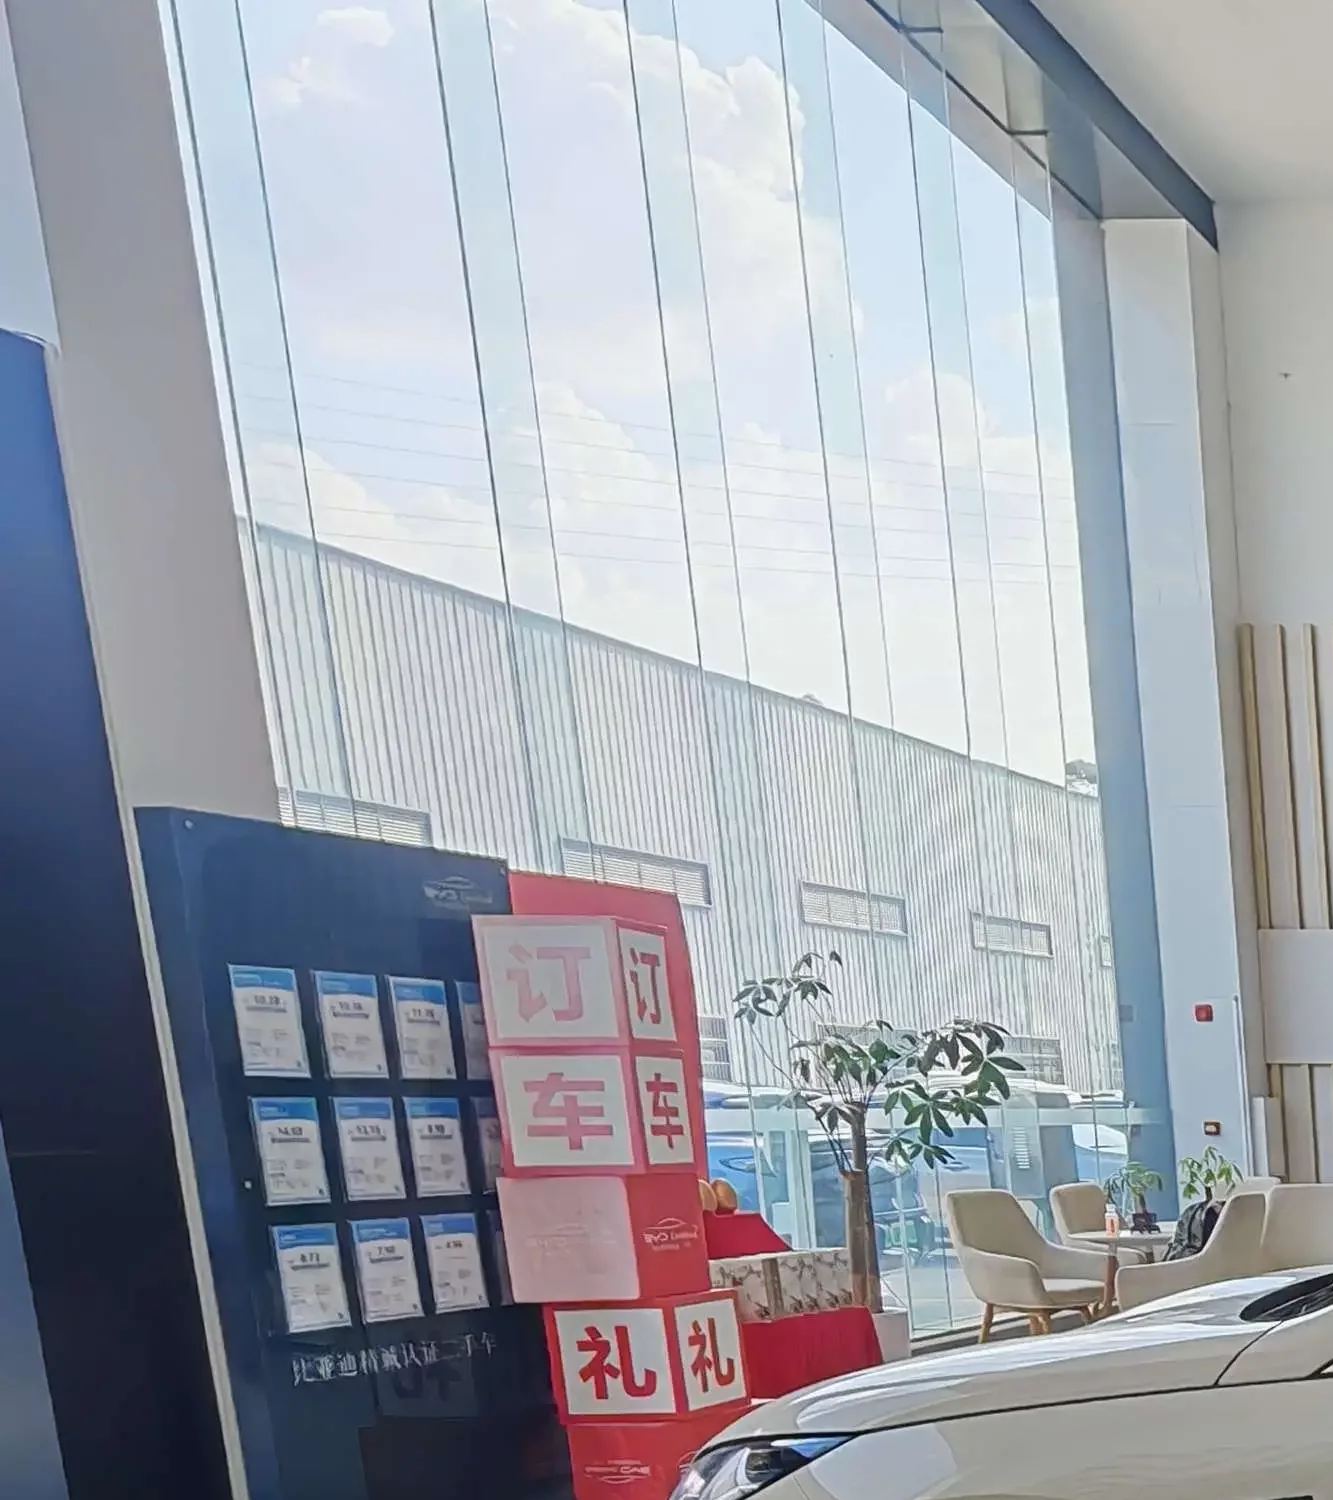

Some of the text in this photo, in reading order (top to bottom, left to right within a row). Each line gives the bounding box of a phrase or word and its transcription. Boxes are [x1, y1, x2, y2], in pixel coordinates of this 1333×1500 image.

[506, 944, 592, 1023] 订
[630, 946, 661, 1025] 订
[523, 1072, 613, 1150] 车
[645, 1072, 685, 1150] 车
[575, 1326, 657, 1399] 礼
[688, 1318, 736, 1393] 礼
